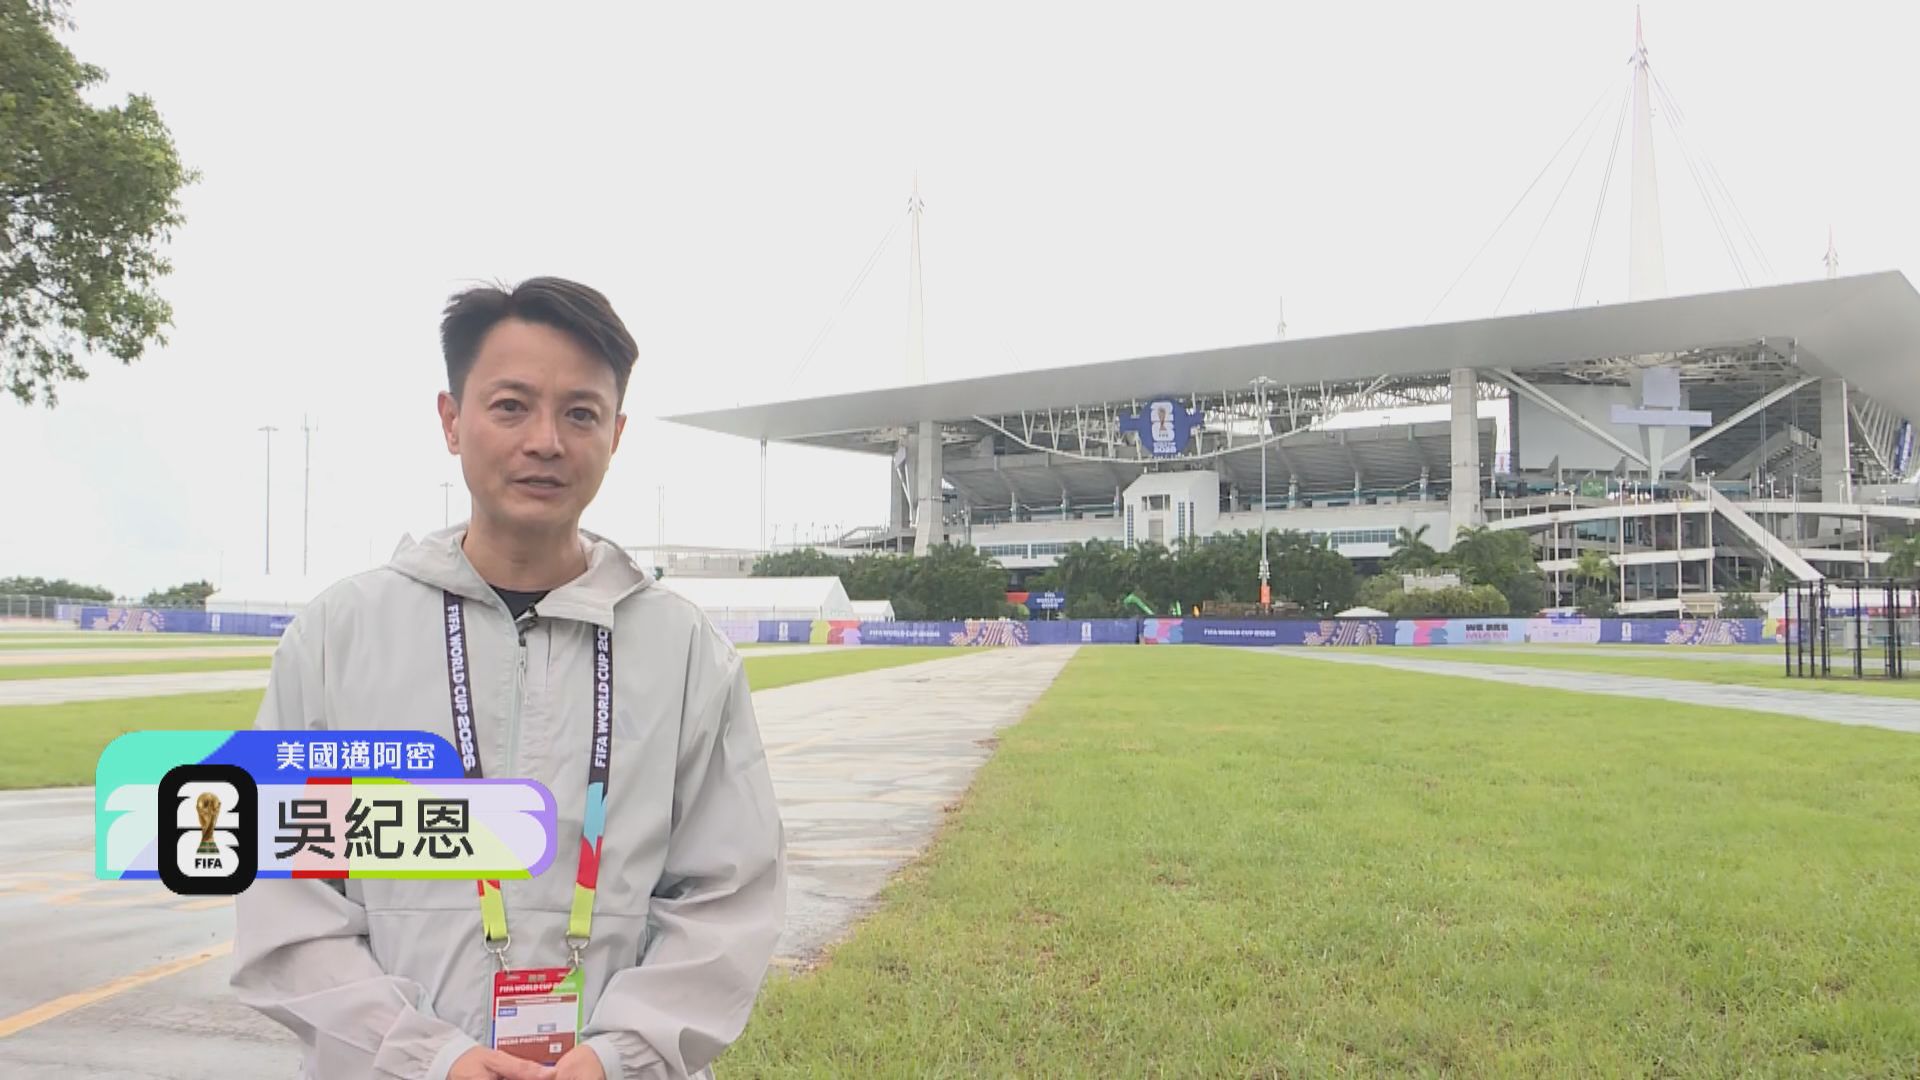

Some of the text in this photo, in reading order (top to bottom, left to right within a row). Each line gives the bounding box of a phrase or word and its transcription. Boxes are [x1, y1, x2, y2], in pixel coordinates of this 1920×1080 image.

[598, 652, 610, 681] CUP
[447, 604, 476, 772] FIFA WORLD CUP 2026
[598, 681, 610, 734] WORLD
[595, 736, 608, 768] FIFA
